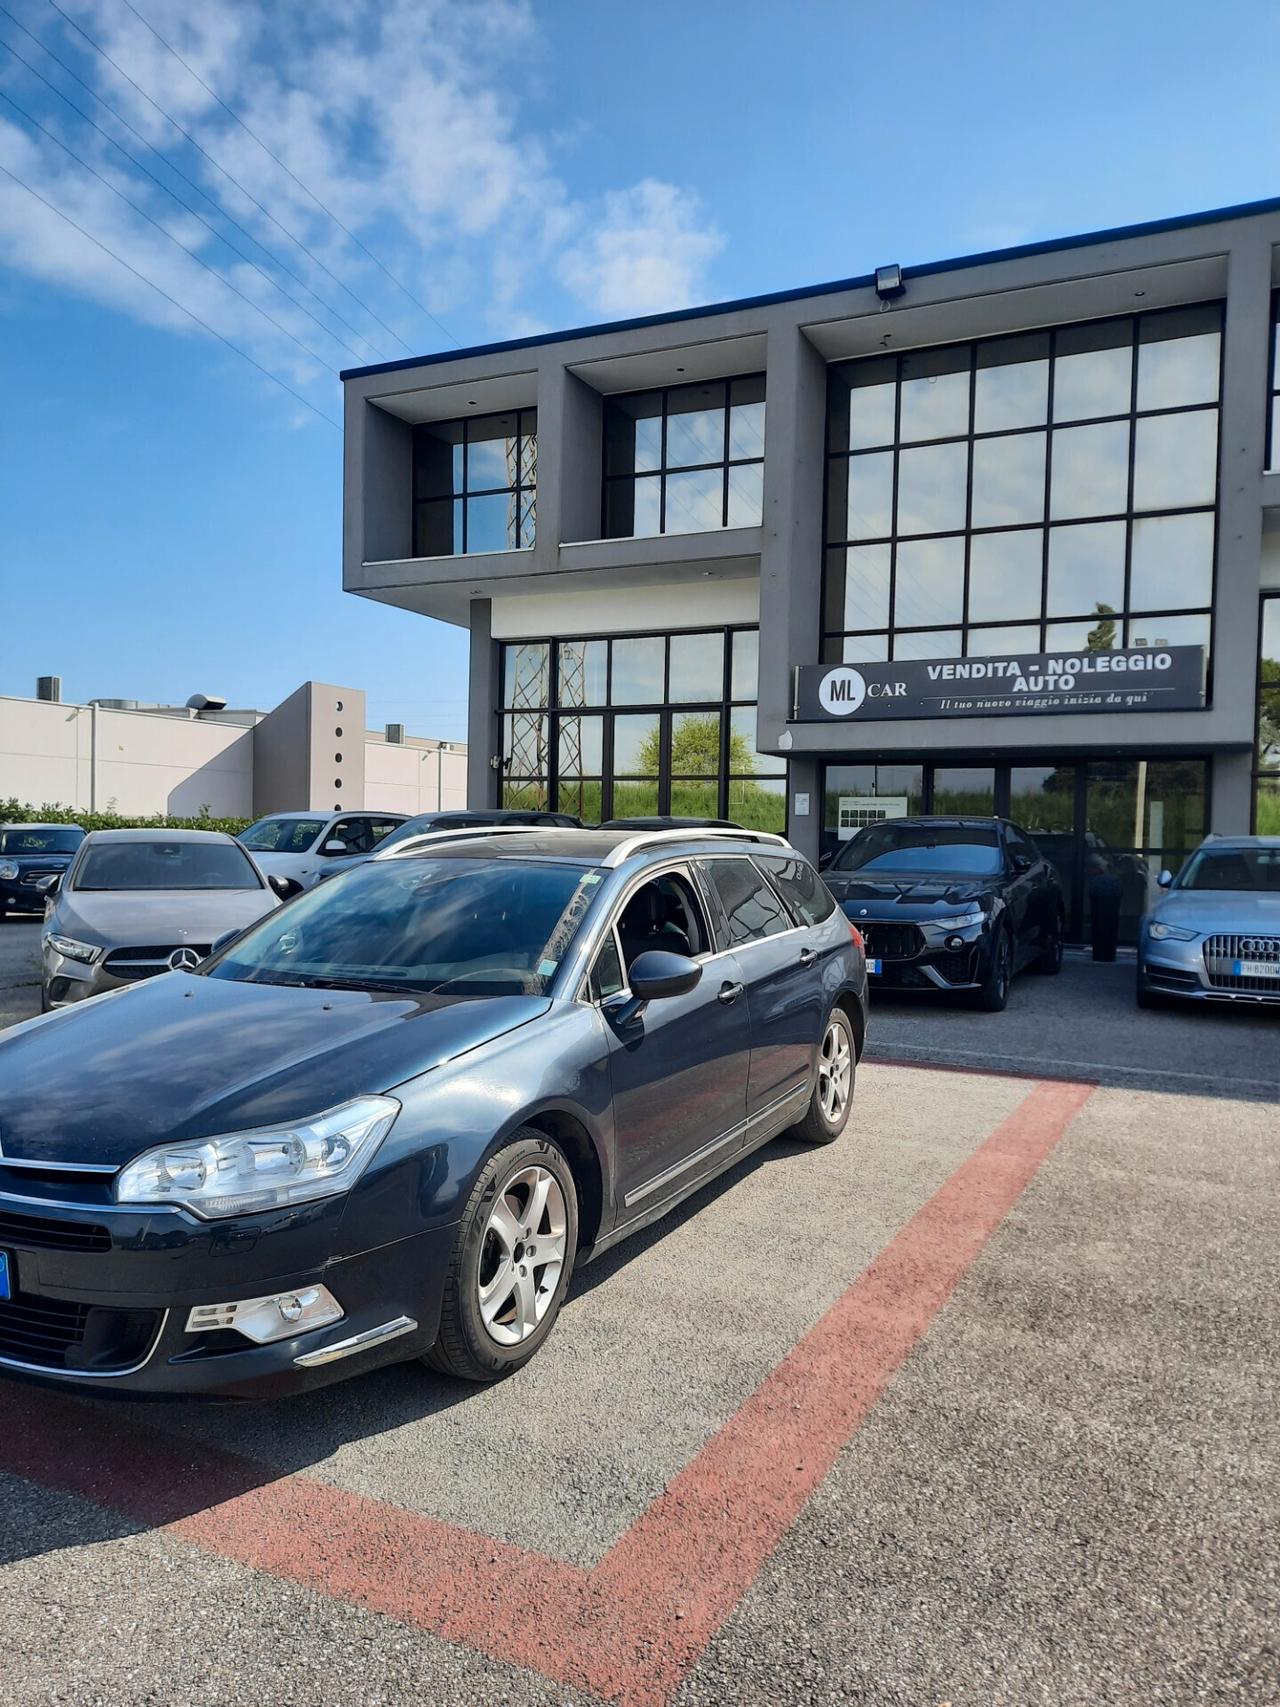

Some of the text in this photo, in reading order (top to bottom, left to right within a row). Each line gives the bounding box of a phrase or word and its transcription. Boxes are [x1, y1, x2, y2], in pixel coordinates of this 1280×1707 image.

[927, 661, 1022, 681] VENDITA
[1047, 653, 1172, 674] NOLEGGIO
[831, 680, 908, 701] ML CAR
[1012, 674, 1076, 692] AUTO
[940, 699, 950, 709] Il
[954, 700, 972, 709] tuo
[976, 699, 1011, 709] nuovo
[1015, 696, 1060, 708] viaggio
[1064, 694, 1102, 705] inizia
[1106, 692, 1122, 703] da
